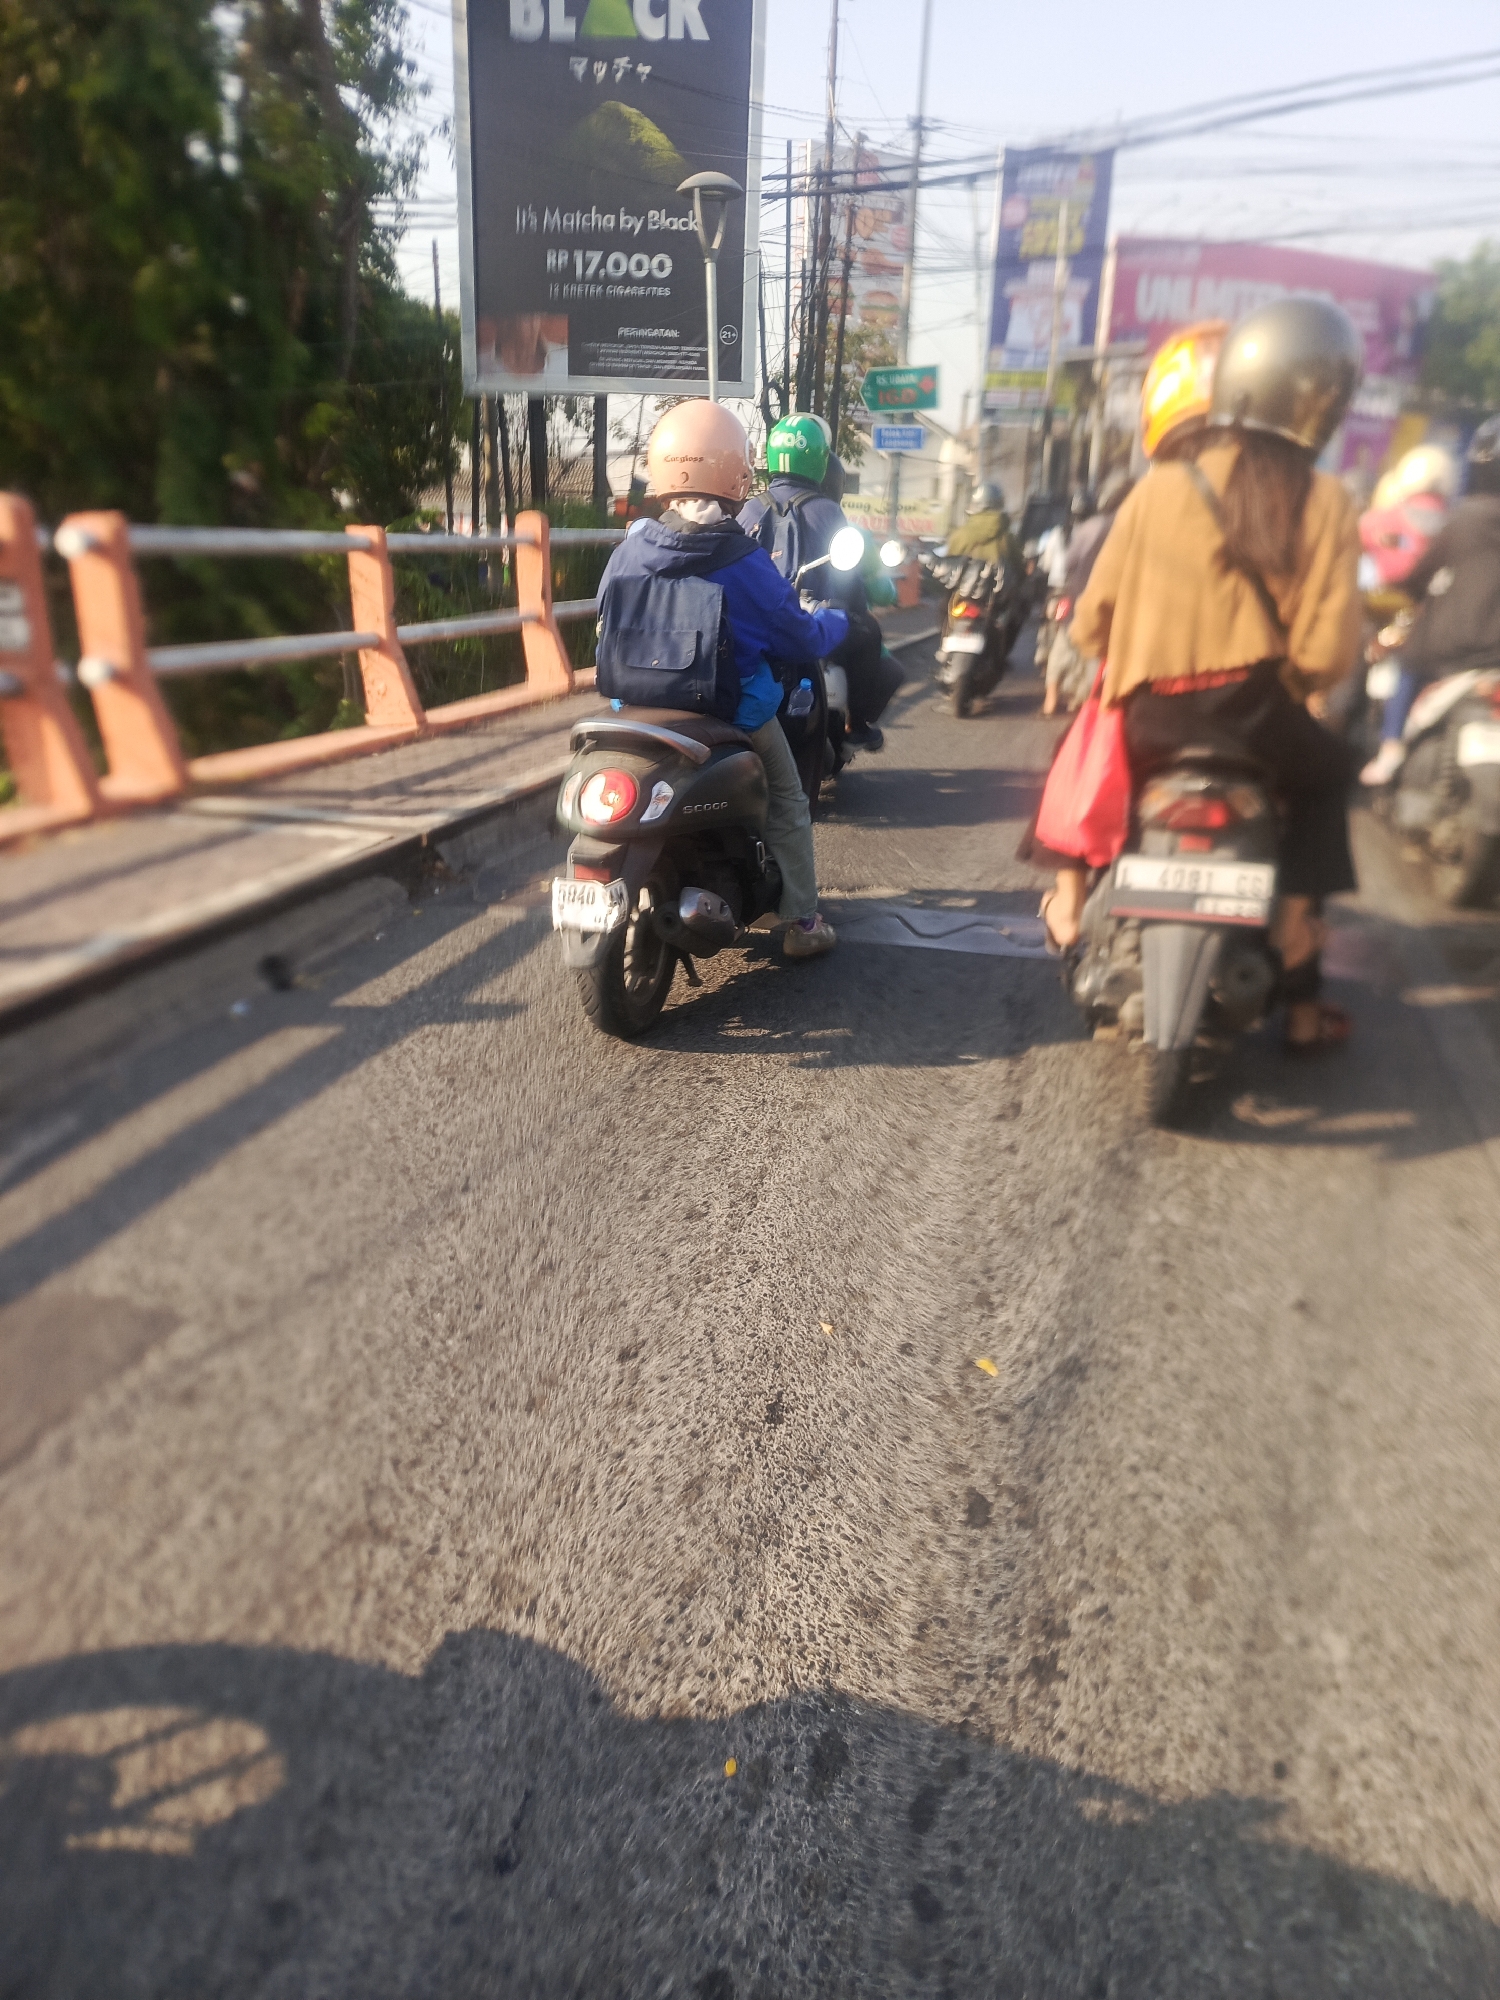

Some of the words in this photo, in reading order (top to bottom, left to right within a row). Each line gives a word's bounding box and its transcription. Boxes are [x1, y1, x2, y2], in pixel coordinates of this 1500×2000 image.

[543, 205, 616, 235] Matcha
[619, 206, 646, 237] by
[648, 208, 699, 233] Black
[573, 248, 673, 282] 17.000
[605, 284, 671, 299] CIGARETTES
[722, 331, 737, 340] 21+
[878, 388, 917, 405] IGD
[770, 430, 807, 449] Grab
[664, 454, 704, 463] Cargloss
